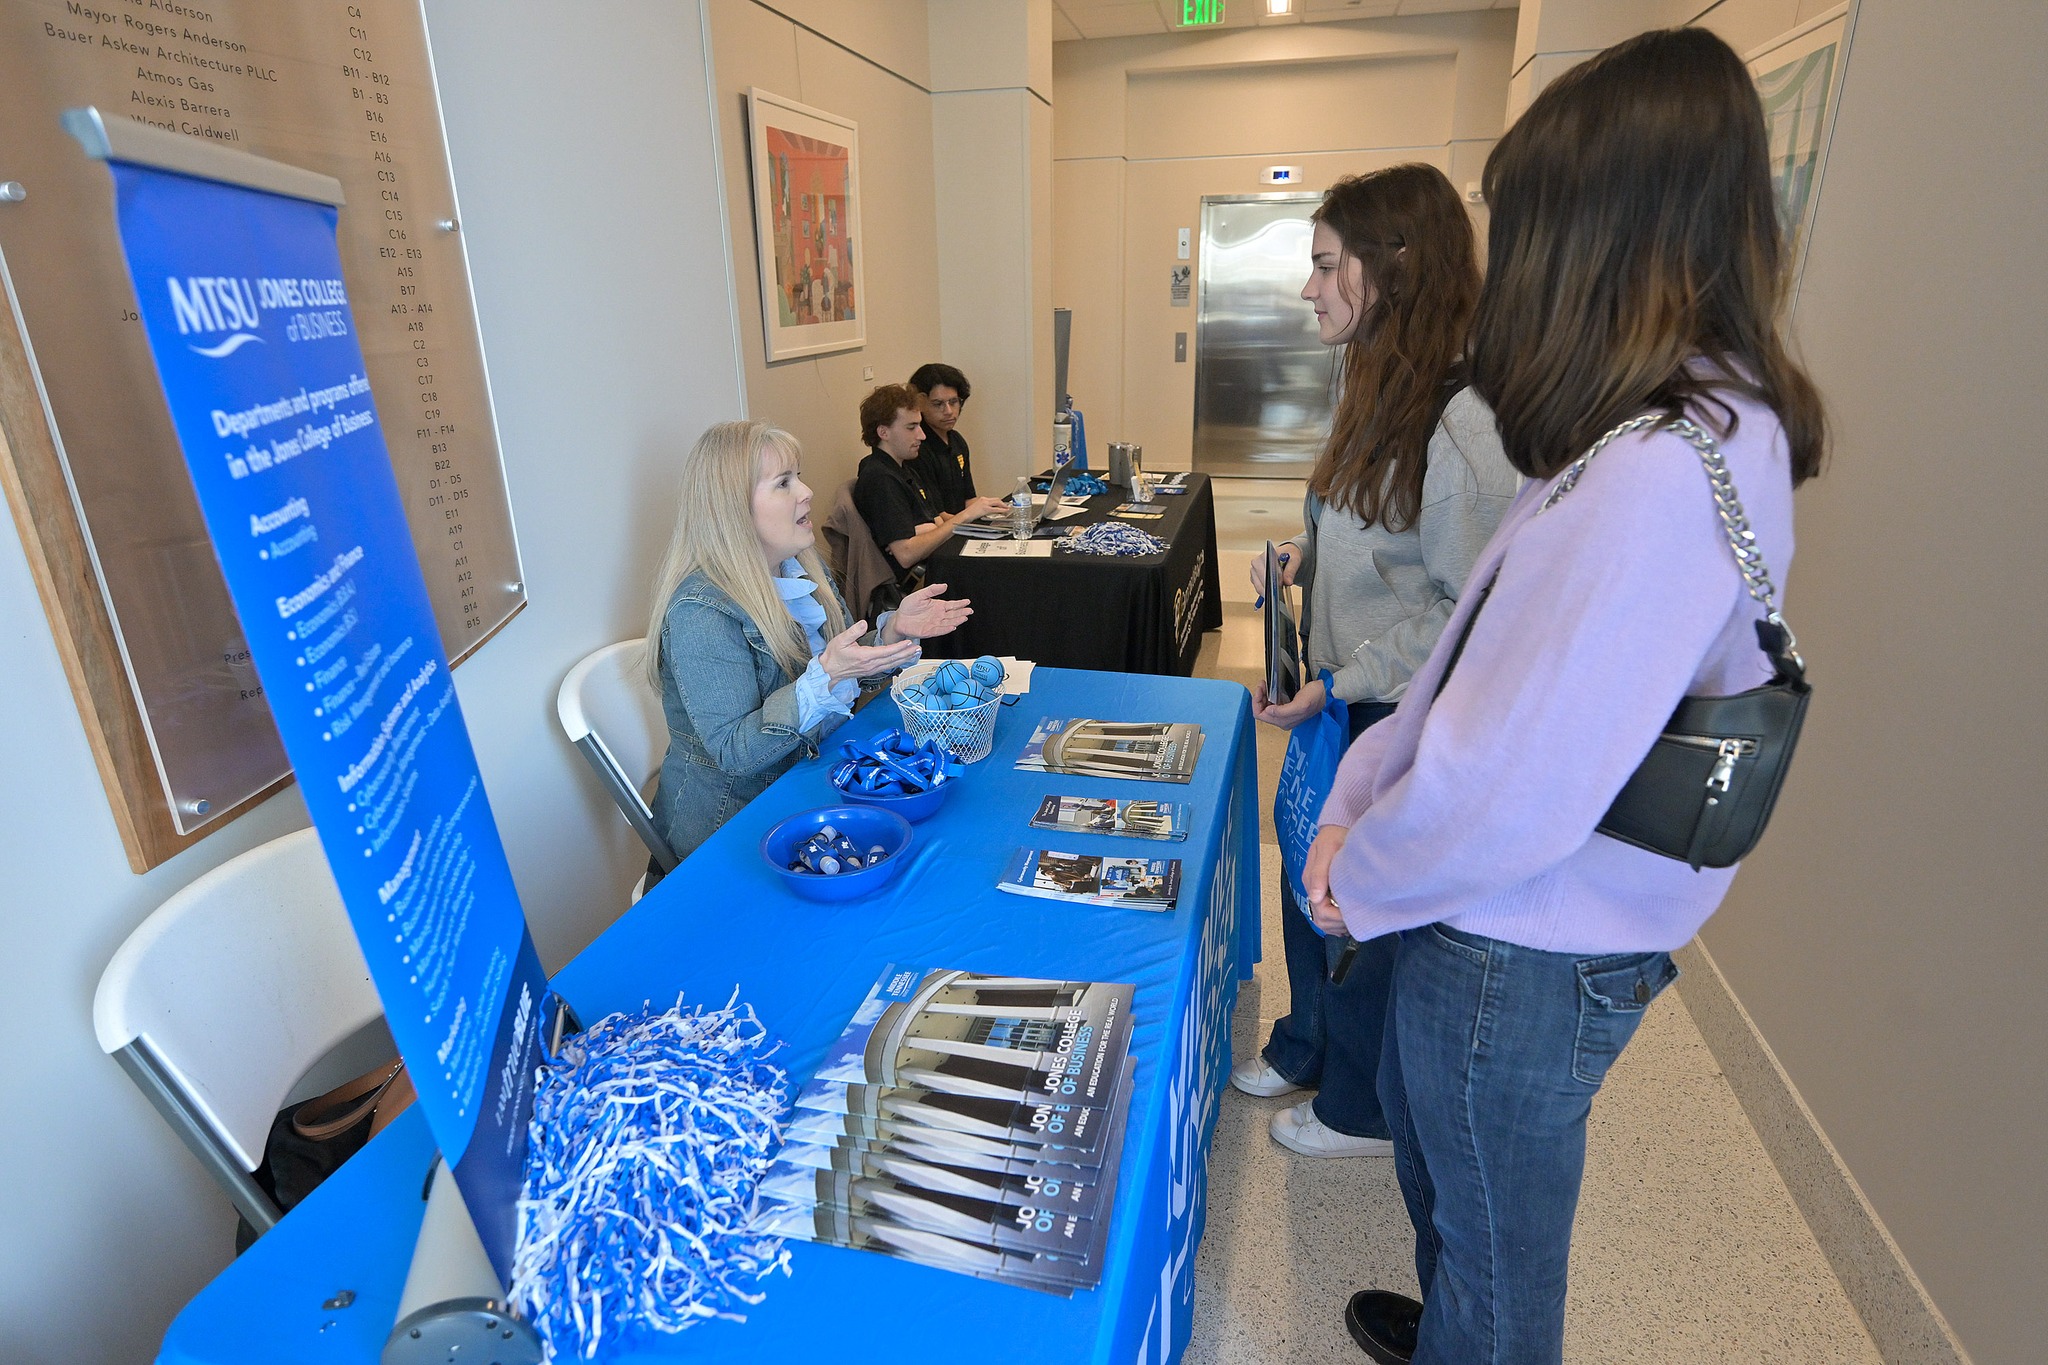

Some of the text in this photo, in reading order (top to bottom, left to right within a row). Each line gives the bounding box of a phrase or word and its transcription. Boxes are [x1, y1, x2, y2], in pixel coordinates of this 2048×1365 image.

[150, 0, 212, 22] Alderson
[347, 6, 362, 19] C4
[1183, 0, 1217, 24] EXIT
[67, 1, 247, 53] Mayor Rogers Anderson
[350, 26, 367, 41] C11
[44, 22, 278, 82] Bauer Askew Architecture PLLC
[354, 48, 372, 62] C12
[137, 66, 214, 92] Atmos Gas
[343, 65, 360, 79] B11
[372, 72, 390, 85] B12
[352, 88, 364, 100] B1
[377, 93, 389, 104] B3
[131, 90, 231, 118] Alexis Barrera
[366, 110, 384, 123] B16
[182, 122, 239, 141] Caldwell
[370, 131, 388, 143] E16
[374, 151, 391, 163] A16
[378, 171, 395, 183] C13
[382, 190, 399, 201] C14
[385, 210, 402, 221] C15
[389, 229, 406, 240] C16
[380, 248, 396, 258] E12
[407, 249, 422, 259] E13
[397, 267, 413, 277] A15
[256, 278, 303, 308] JONES
[401, 286, 415, 295] B17
[167, 276, 260, 334] MTSU
[391, 304, 407, 314] A13
[418, 304, 433, 313] A14
[298, 310, 348, 340] BUSINESS
[408, 322, 424, 332] A18
[413, 340, 425, 349] C2
[417, 358, 428, 367] C3
[418, 375, 433, 385] C17
[421, 393, 438, 402] C18
[425, 409, 441, 420] C19
[417, 429, 431, 439] F11
[441, 425, 454, 435] F14
[225, 453, 249, 480] in
[246, 444, 273, 473] the
[270, 439, 302, 464] Jones
[297, 424, 332, 450] College
[432, 443, 447, 454] B13
[435, 460, 451, 470] B22
[430, 479, 441, 489] D1
[451, 474, 462, 485] D5
[429, 495, 444, 507] D11
[454, 489, 469, 500] D15
[446, 509, 459, 519] E11
[449, 524, 463, 536] A19
[453, 541, 463, 550] C1
[455, 556, 468, 567] A11
[458, 571, 472, 583] A12
[461, 587, 474, 598] A17
[464, 602, 478, 614] B14
[467, 617, 481, 629] B15
[976, 663, 991, 672] MTSU
[1044, 1010, 1082, 1094] JONES COLLEGE
[1086, 998, 1118, 1098] AN EDUCATION FOR THE REAL WORLD
[1060, 1026, 1094, 1095] OF BUSINESS
[1030, 1104, 1052, 1132] JON
[1048, 1114, 1066, 1134] OF
[1074, 1124, 1084, 1138] AN
[1071, 1188, 1082, 1202] AN
[1016, 1206, 1036, 1230] JO
[1035, 1208, 1054, 1232] OF
[1064, 1222, 1076, 1238] AN
